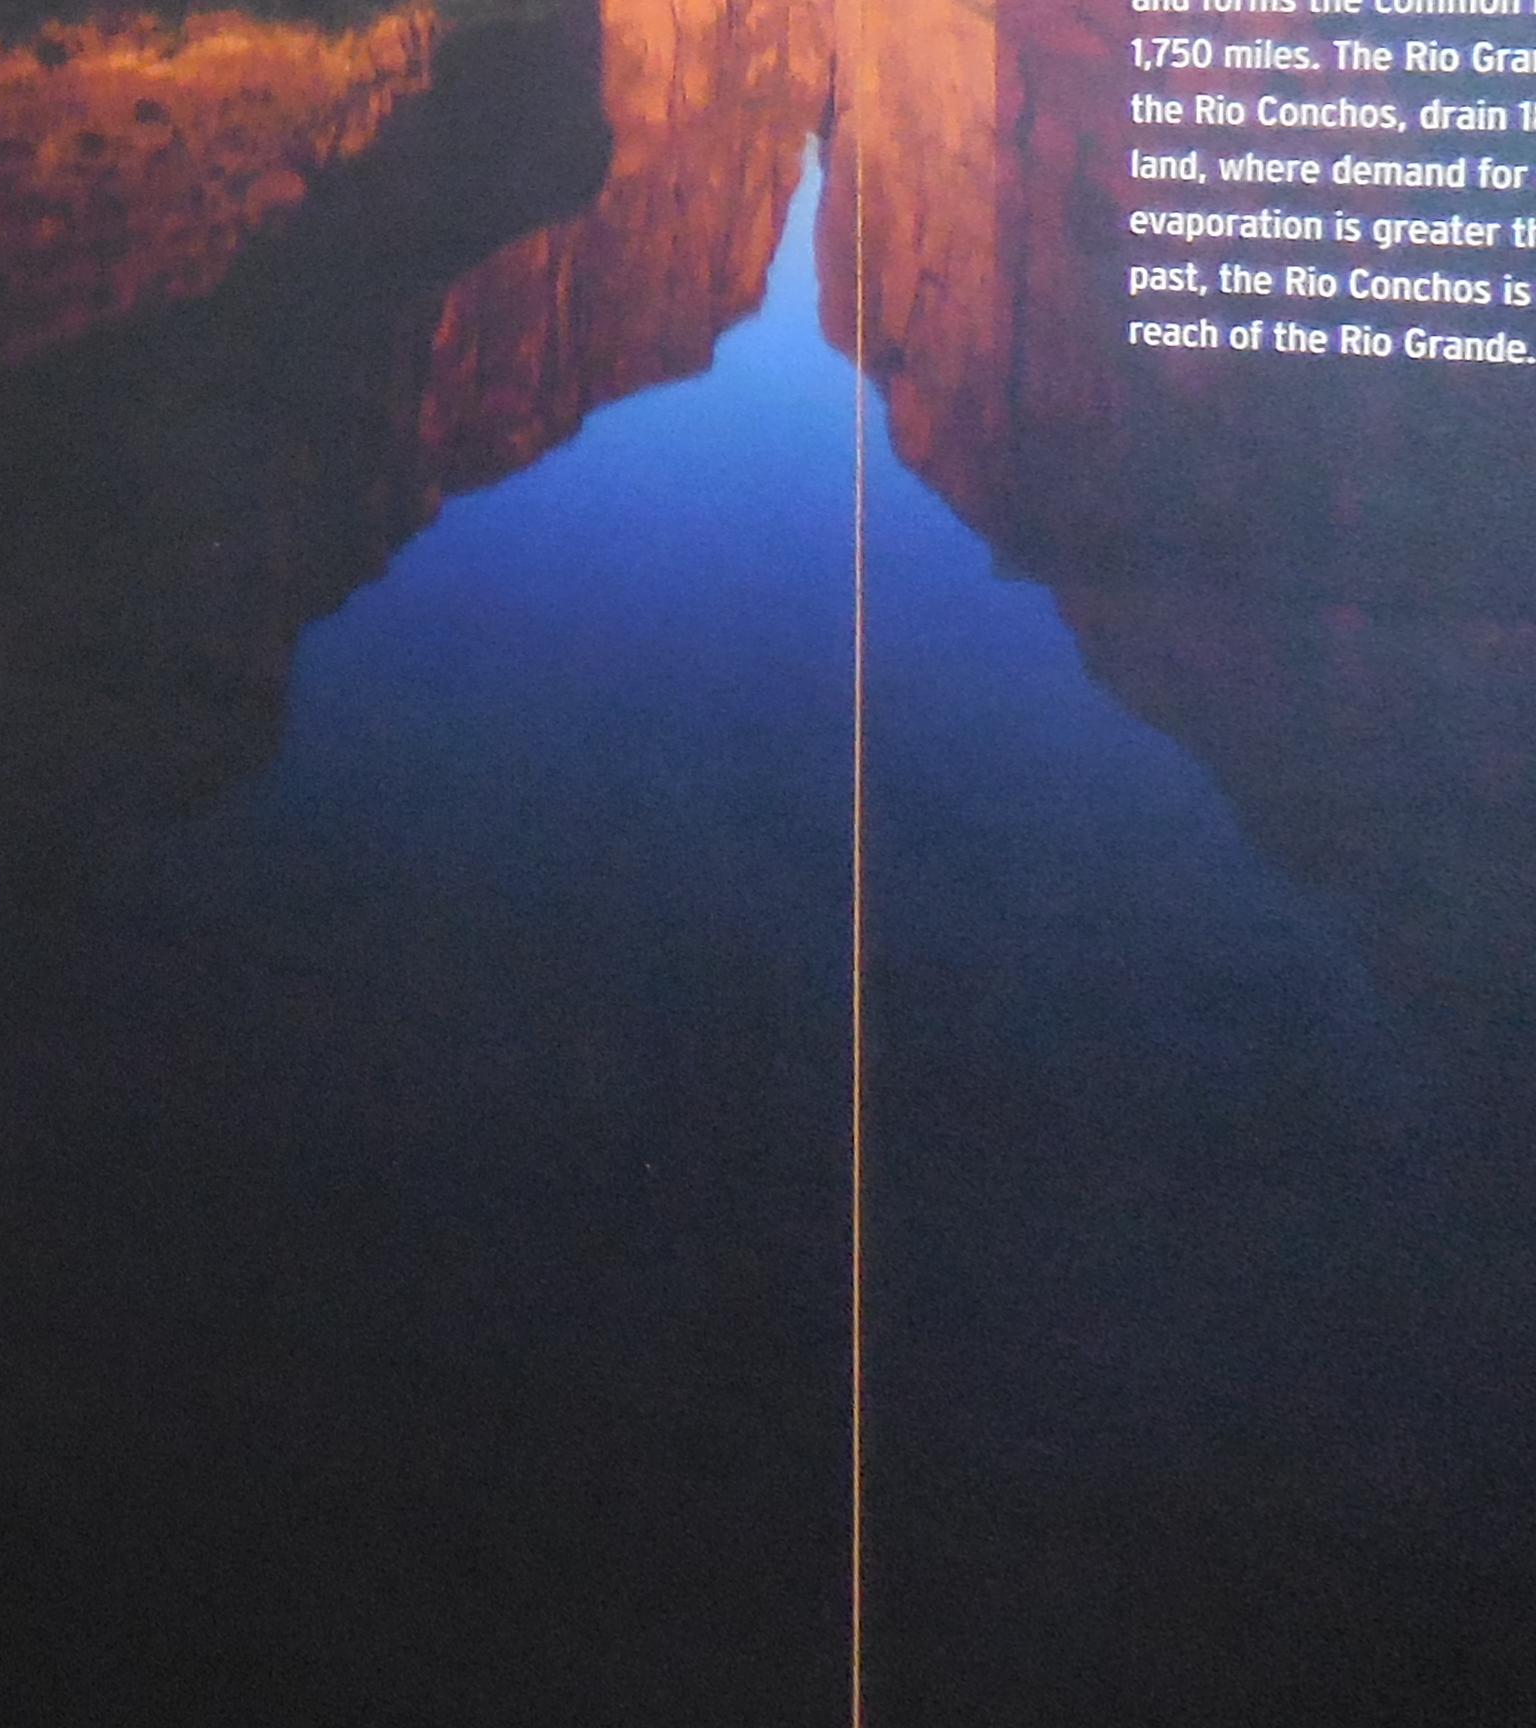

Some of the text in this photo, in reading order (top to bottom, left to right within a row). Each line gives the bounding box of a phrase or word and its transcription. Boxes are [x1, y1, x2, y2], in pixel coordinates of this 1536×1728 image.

[1130, 38, 1212, 71] 1,750
[1224, 39, 1320, 70] miles.
[1333, 40, 1392, 71] The
[1405, 40, 1459, 71] Rio
[1131, 94, 1182, 125] the
[1195, 94, 1244, 125] Rio
[1257, 95, 1406, 133] Conchos,
[1419, 99, 1507, 130] drain
[1131, 149, 1528, 189] land, where demand for
[1129, 209, 1322, 242] evaporation
[1335, 211, 1360, 242] is
[1373, 216, 1500, 249] greater
[1129, 263, 1530, 306] past, the Rio Conchos is
[1129, 319, 1536, 364] reach of the Rio Grande.
